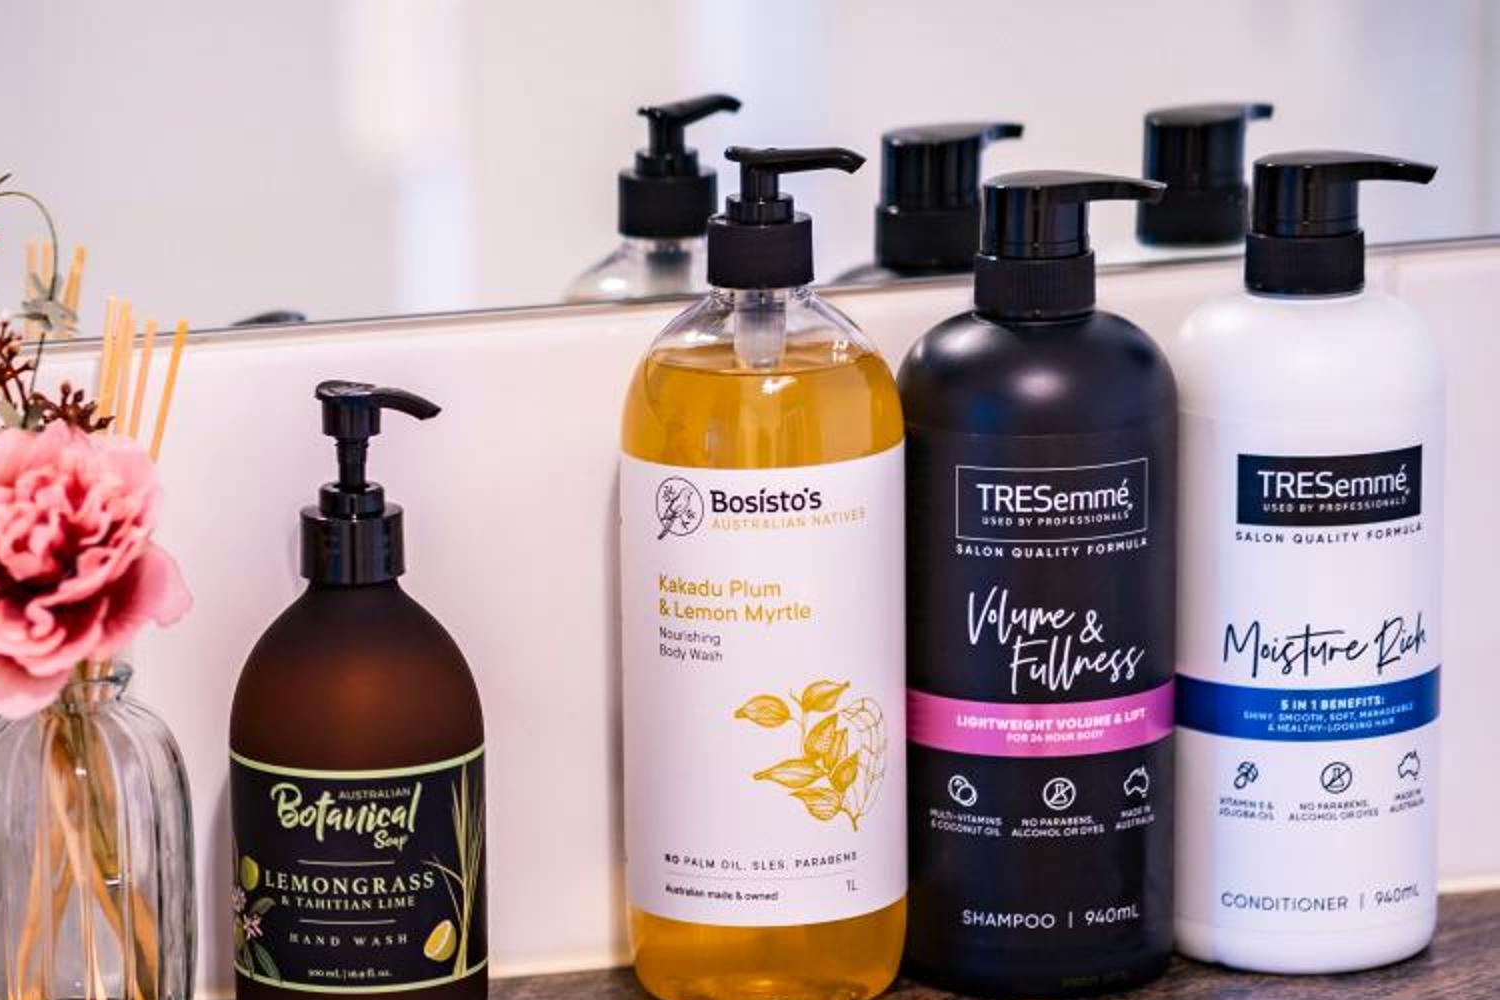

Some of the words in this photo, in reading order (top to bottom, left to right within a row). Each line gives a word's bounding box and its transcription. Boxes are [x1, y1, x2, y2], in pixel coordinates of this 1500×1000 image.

[1257, 464, 1407, 499] TRESemmé
[976, 478, 1130, 513] TRESemmé
[1263, 503, 1294, 513] USED
[1299, 504, 1313, 513] BY
[1319, 497, 1407, 513] PROFESSIONALS
[711, 517, 806, 531] AUSTRALIAN
[811, 507, 866, 526] NATIVES
[981, 516, 1012, 526] USED
[1018, 516, 1032, 526] BY
[1037, 511, 1129, 526] PROFESSIONALS
[1236, 532, 1284, 543] SALON
[1293, 532, 1359, 544] QUALITY
[1367, 523, 1423, 540] FORMULA
[955, 544, 1003, 557] SALON
[1012, 547, 1079, 558] QUALITY
[1087, 538, 1147, 554] FORMULA
[659, 574, 722, 597] Kakadu
[729, 580, 781, 598] Plum
[659, 598, 670, 617] &
[675, 601, 738, 621] Lemon
[745, 602, 812, 625] Myrtle
[968, 586, 1076, 645] Volume
[1079, 610, 1104, 643] &
[659, 627, 721, 646] Nourishing
[1224, 621, 1369, 678] Moisture
[1374, 612, 1426, 676] Rich
[659, 644, 685, 660] Body
[690, 647, 723, 662] Wash
[1010, 635, 1145, 695] Fullness
[1281, 700, 1288, 711] 5
[1291, 699, 1306, 711] IN
[1311, 699, 1317, 710] 1
[1320, 695, 1385, 710] BENEFITS:
[957, 715, 1052, 731] LIGHTWEIGHT
[1057, 715, 1111, 730] VOLUME
[1114, 714, 1121, 724] &
[1124, 708, 1146, 722] LIFT
[1268, 724, 1275, 732] &
[1006, 732, 1028, 743] FOR
[1031, 733, 1043, 743] 24
[1045, 732, 1074, 743] HOUR
[1077, 730, 1105, 741] BODY
[338, 787, 411, 800] AUSTRALIAN
[271, 781, 422, 842] Botanical
[1219, 808, 1256, 819] JOJOBA
[1259, 810, 1274, 820] OIL
[1288, 811, 1338, 821] ALCOHOL
[1340, 810, 1355, 819] OR
[1356, 807, 1379, 818] DYES
[1299, 803, 1315, 811] NO
[938, 820, 982, 834] COCONUT
[984, 826, 1000, 837] OIL
[1011, 827, 1061, 838] ALCOHOL
[1064, 827, 1079, 836] OR
[1080, 824, 1104, 834] DYES
[1021, 817, 1038, 827] NO
[374, 830, 408, 851] Soap
[664, 854, 679, 865] NO
[683, 856, 715, 868] PALM
[795, 852, 858, 868] PARABENS
[265, 870, 435, 894] LEMONGRASS
[847, 879, 859, 891] 1L
[665, 884, 705, 898] Australian
[708, 889, 732, 900] made
[736, 891, 742, 900] &
[745, 891, 778, 901] owned
[1221, 892, 1349, 912] CONDITIONER
[1375, 884, 1420, 905] 940mL
[281, 896, 289, 905] &
[296, 896, 372, 910] TAHITIAN
[378, 896, 415, 908] LIME
[962, 910, 1056, 928] SHAMPOO
[1085, 904, 1140, 926] 940mL
[289, 933, 341, 947] HAND
[354, 934, 407, 946] WASH
